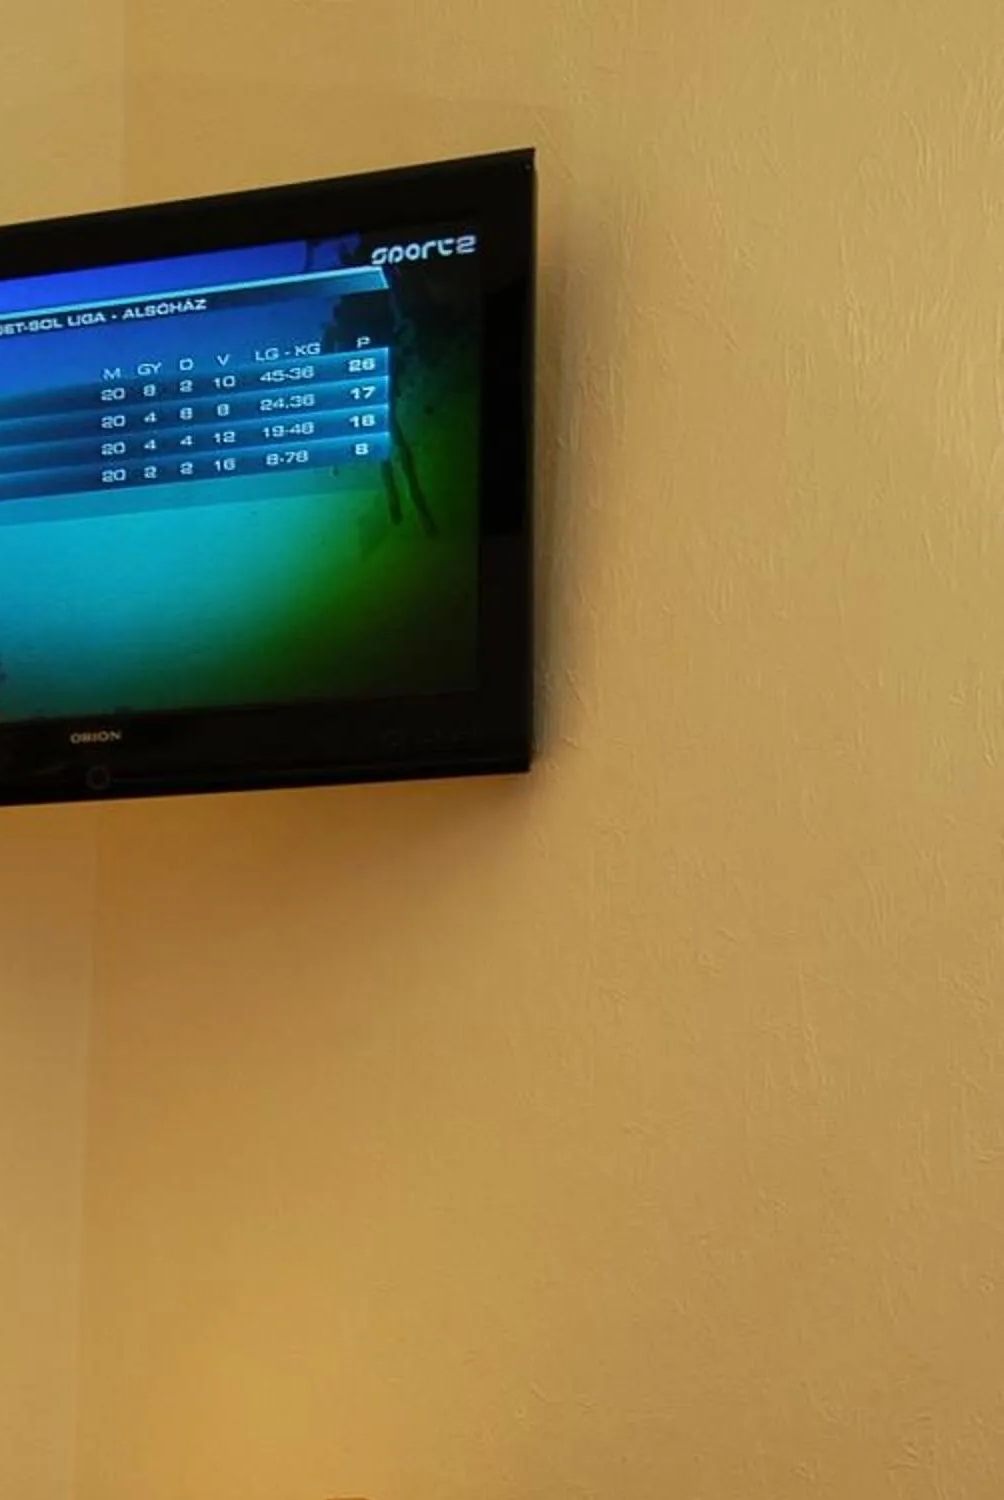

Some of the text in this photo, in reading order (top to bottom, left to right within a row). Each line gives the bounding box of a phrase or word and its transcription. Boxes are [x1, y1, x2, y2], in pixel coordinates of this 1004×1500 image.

[67, 311, 106, 327] LIGA
[103, 367, 121, 380] M
[137, 361, 162, 376] GY
[216, 353, 231, 367] V
[255, 347, 279, 361] LG
[294, 342, 321, 357] KG
[356, 336, 370, 348] P
[100, 387, 125, 401] 20
[213, 375, 236, 389] 10
[101, 415, 126, 429] 20
[143, 411, 157, 423] 4
[350, 386, 375, 400] 17
[101, 442, 126, 456] 20
[143, 439, 156, 451] 4
[179, 435, 193, 447] 4
[214, 431, 236, 445] 12
[101, 469, 127, 483] 20
[70, 729, 123, 745] ORION
